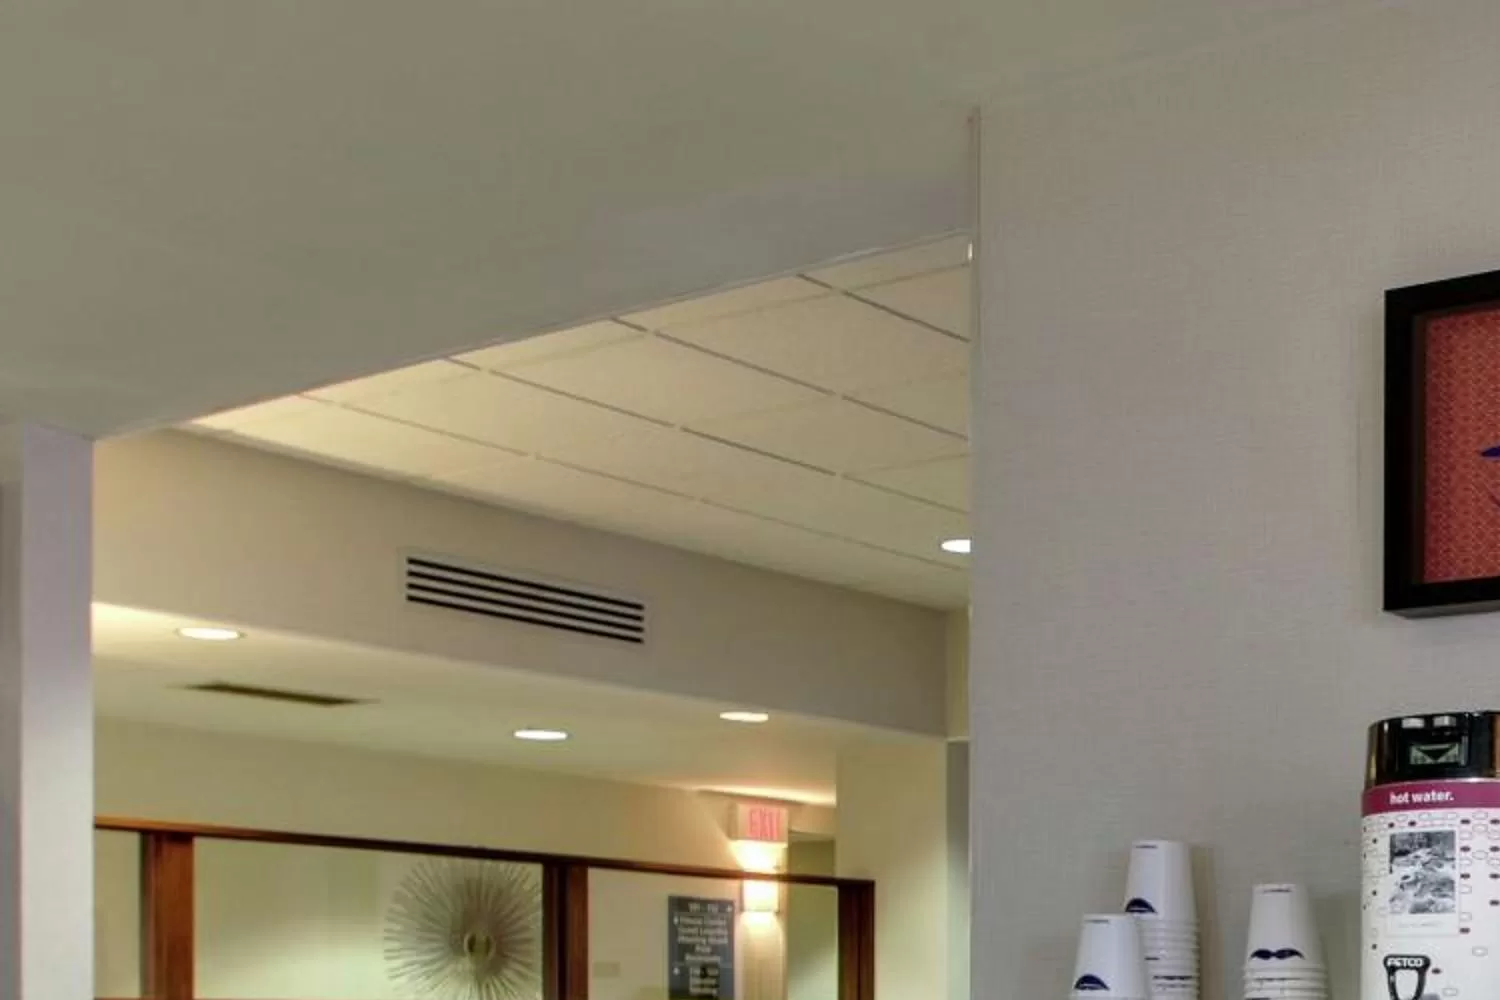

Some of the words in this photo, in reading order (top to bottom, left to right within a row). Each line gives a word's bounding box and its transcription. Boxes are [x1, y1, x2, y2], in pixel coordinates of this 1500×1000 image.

[1389, 791, 1409, 804] hot
[1412, 789, 1454, 804] water.
[748, 807, 781, 839] EXIT
[1387, 957, 1425, 968] FETCO
